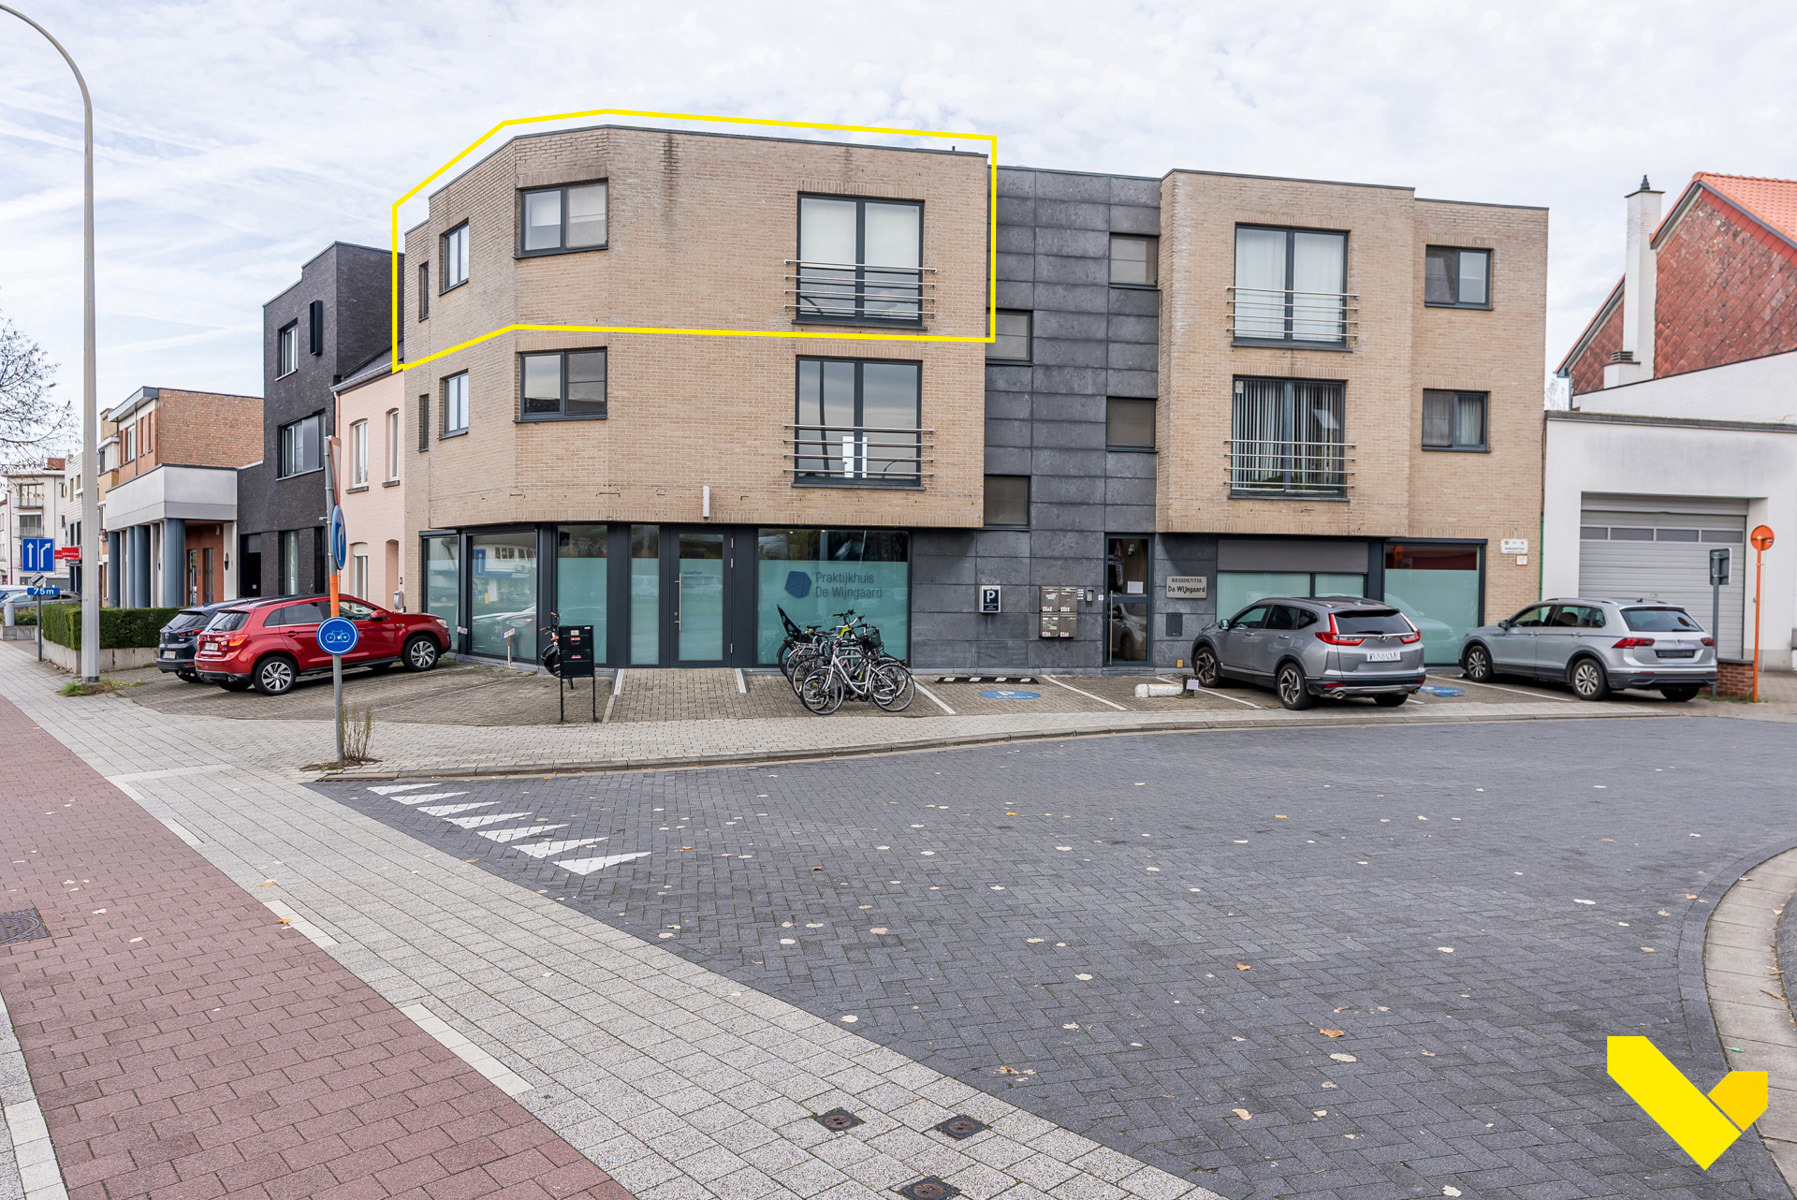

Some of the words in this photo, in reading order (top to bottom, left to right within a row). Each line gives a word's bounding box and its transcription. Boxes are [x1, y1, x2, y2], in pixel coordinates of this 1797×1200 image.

[815, 571, 875, 586] Praktijkhuis
[815, 586, 829, 598] De
[831, 586, 883, 601] Wijngaard
[986, 590, 996, 603] P
[1167, 585, 1176, 593] De
[1176, 585, 1206, 594] Wijngaard
